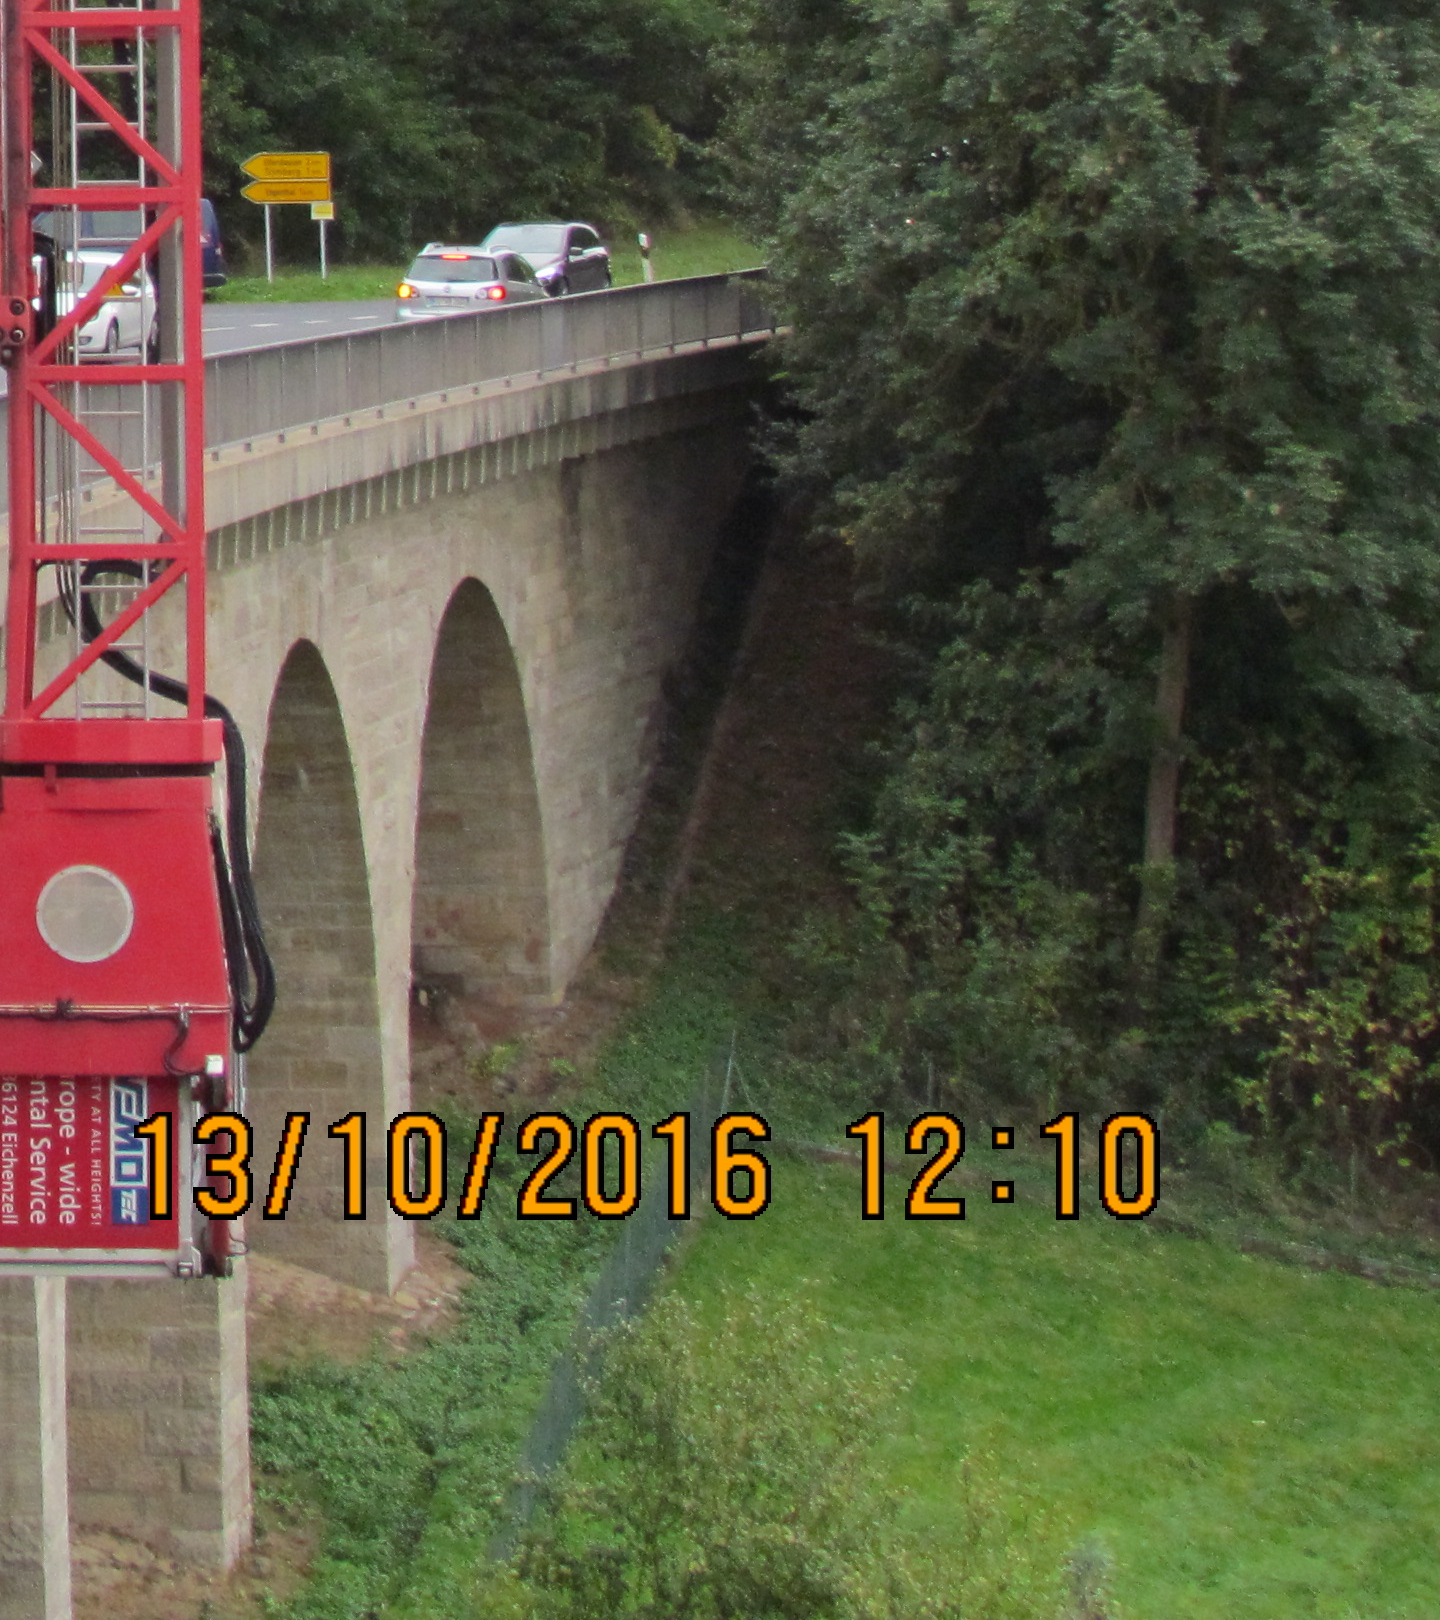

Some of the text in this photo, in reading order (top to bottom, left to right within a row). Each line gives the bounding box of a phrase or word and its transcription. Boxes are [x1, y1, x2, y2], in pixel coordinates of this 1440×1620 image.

[54, 1077, 75, 1138] rope
[91, 1106, 102, 1123] AT
[30, 1078, 53, 1224] ntal Service
[91, 1129, 102, 1153] ALL
[114, 1078, 145, 1223] EMO TEC
[2, 1133, 19, 1224] Eichenzell
[59, 1163, 82, 1224] wide
[91, 1159, 102, 1226] HEIGHTS!
